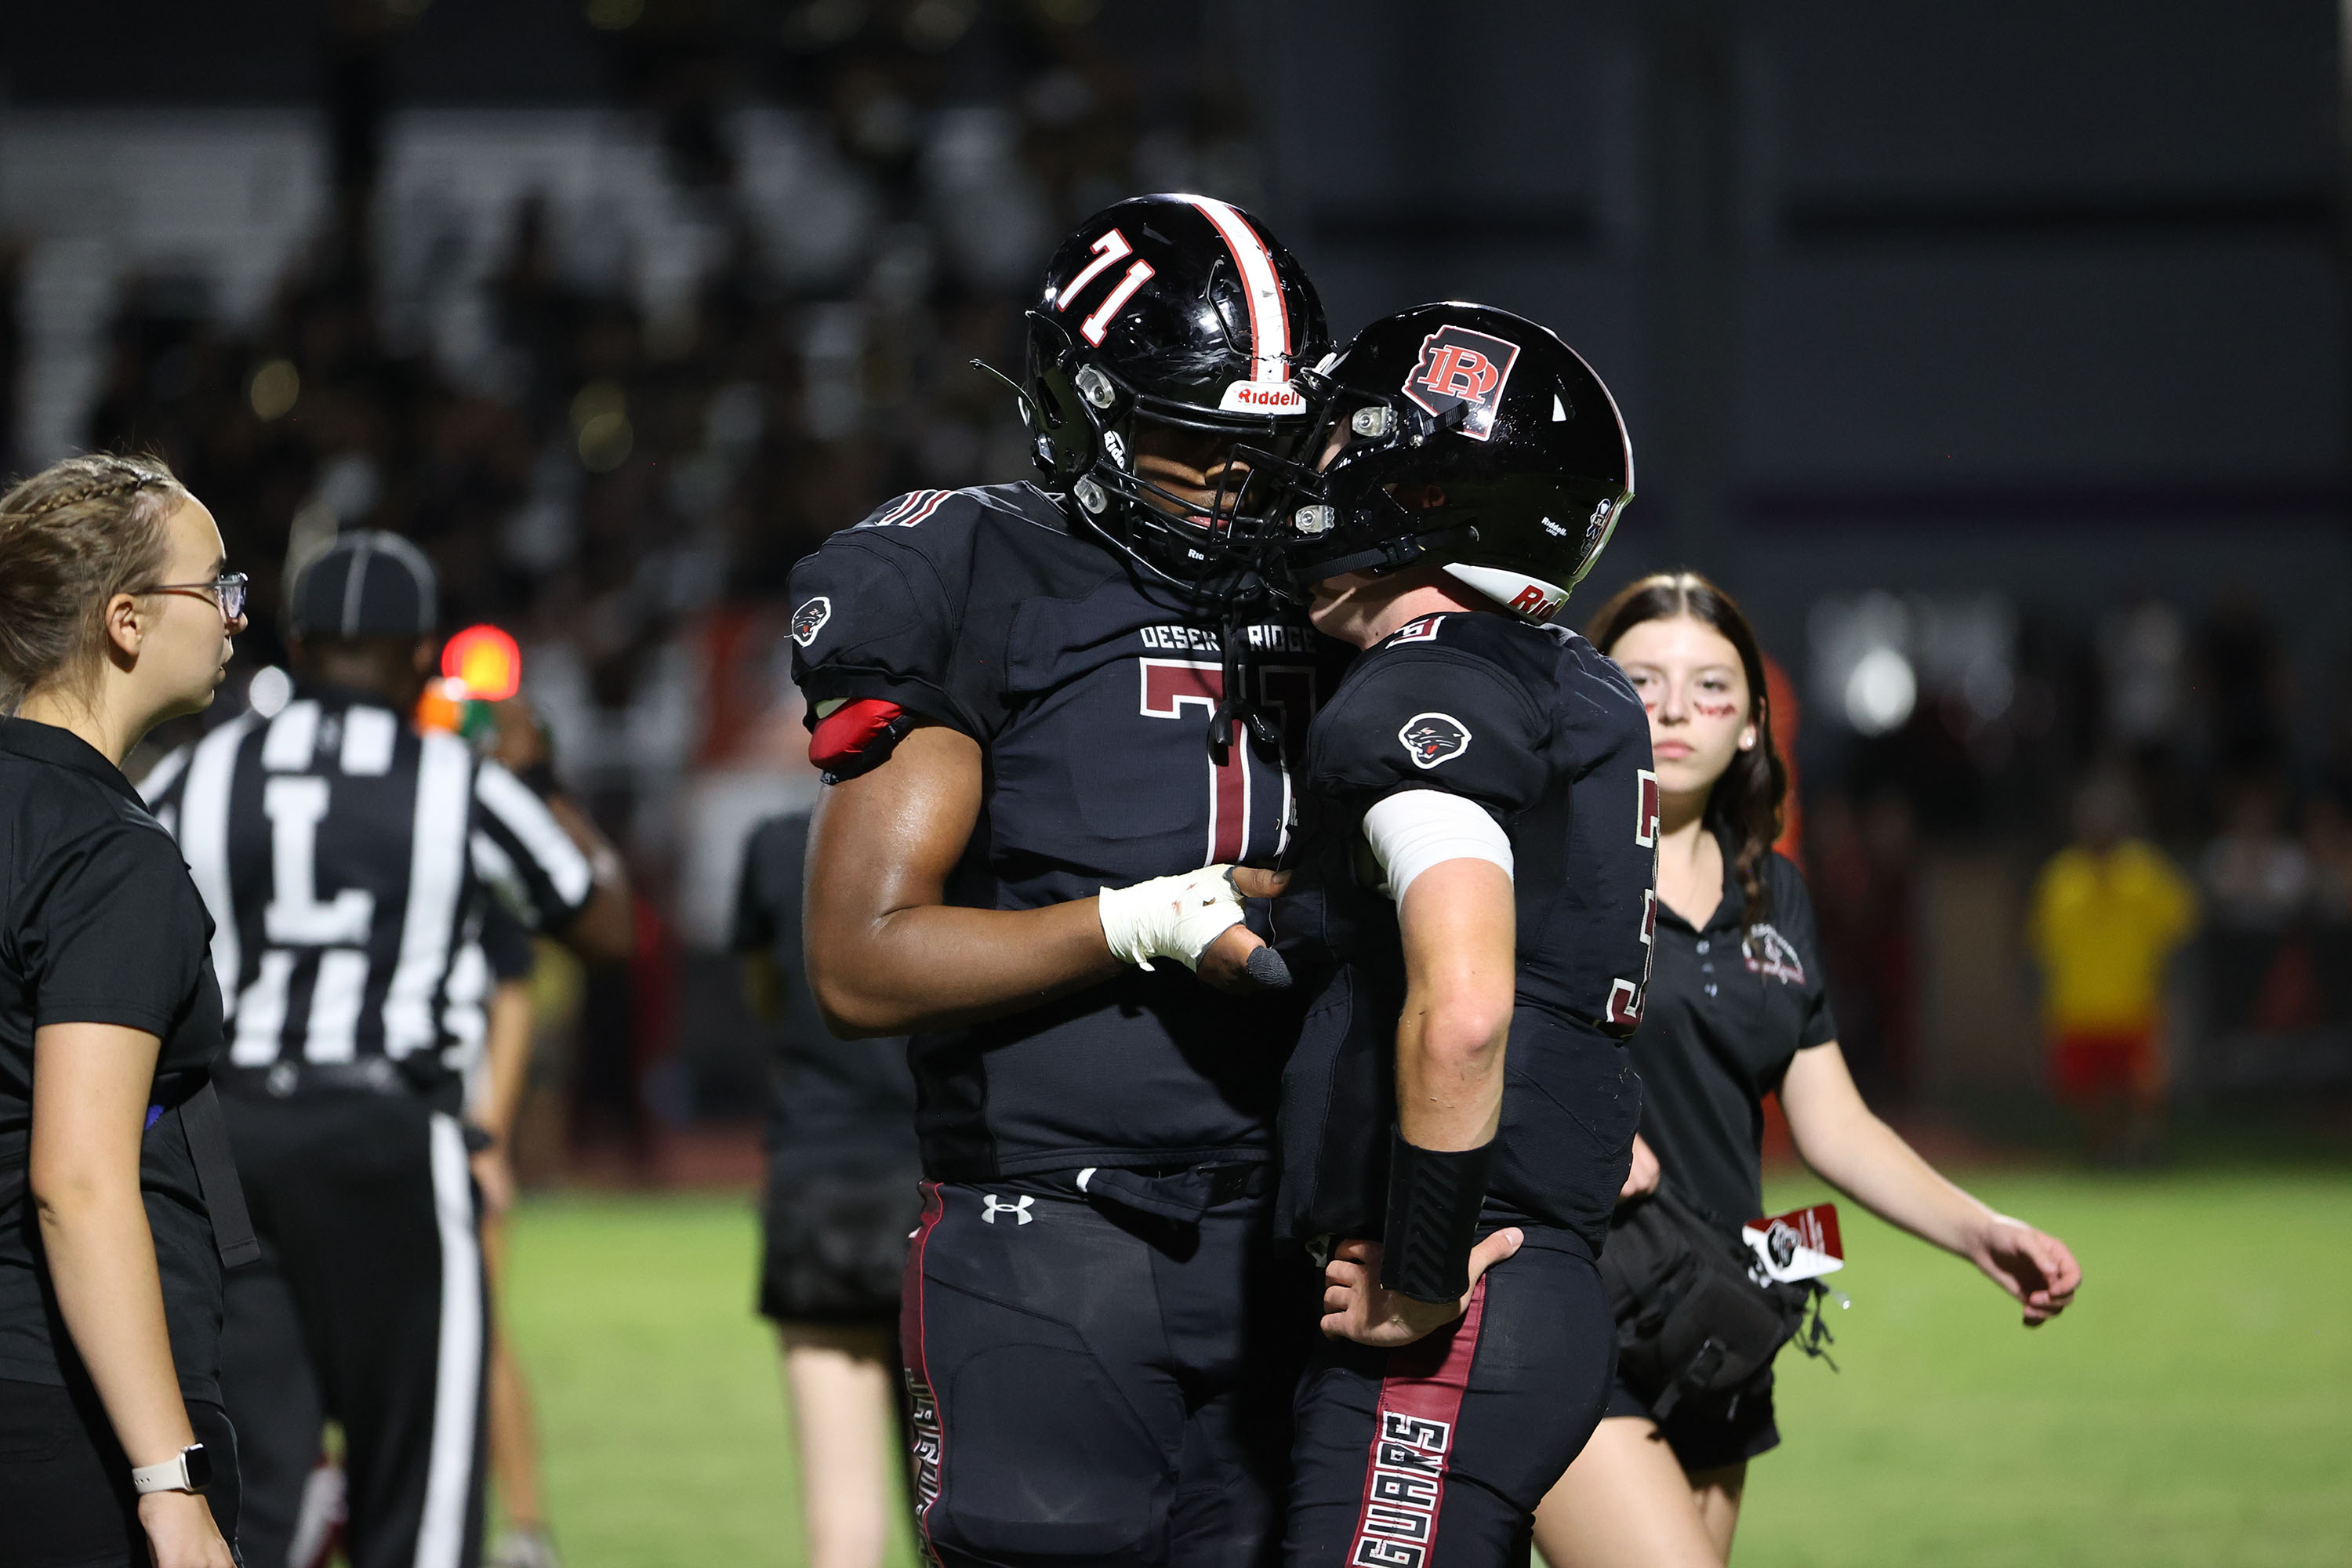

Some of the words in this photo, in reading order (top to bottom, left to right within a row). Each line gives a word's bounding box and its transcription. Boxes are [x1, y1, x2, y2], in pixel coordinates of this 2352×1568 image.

[1056, 227, 1156, 348] 71
[1238, 388, 1300, 405] Riddell
[1140, 625, 1221, 652] DESER
[1247, 624, 1319, 653] RIDGE
[263, 775, 376, 944] L
